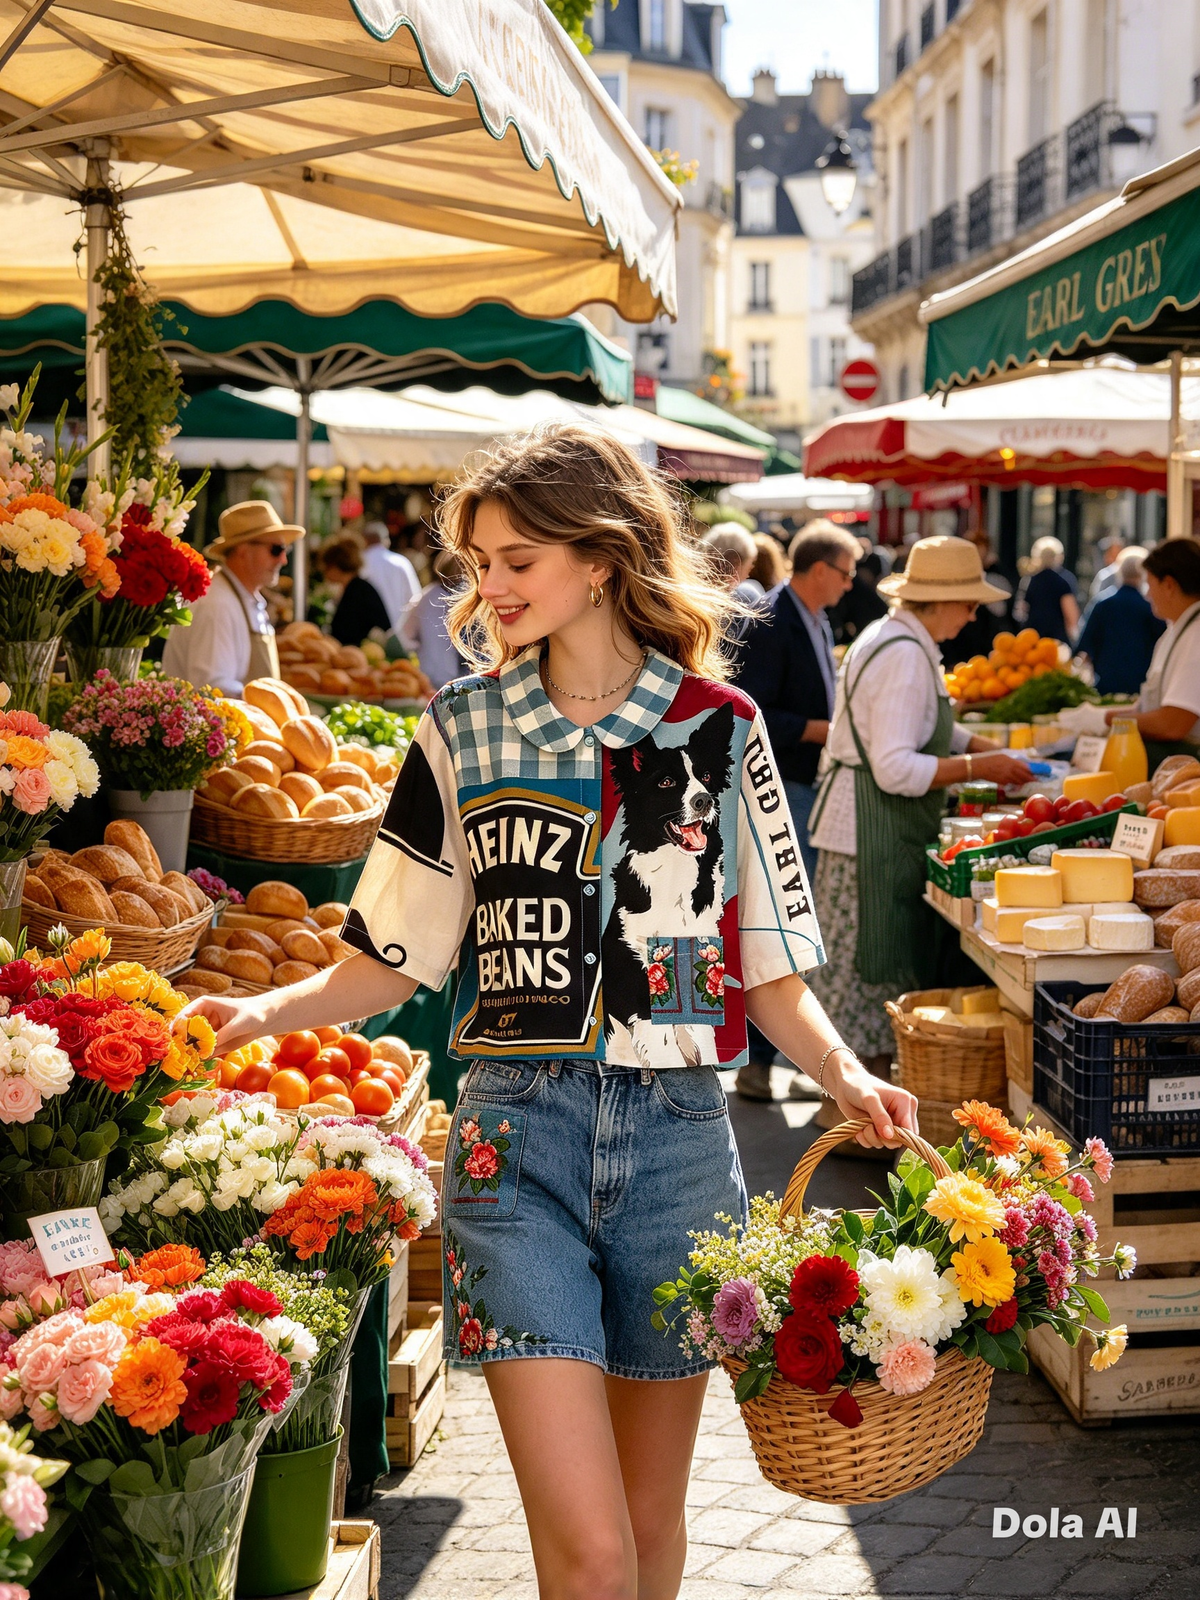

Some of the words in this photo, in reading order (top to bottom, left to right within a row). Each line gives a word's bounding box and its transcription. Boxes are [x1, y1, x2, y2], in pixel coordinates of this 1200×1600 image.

[1026, 271, 1085, 340] EARL
[467, 816, 572, 880] HEINZ
[476, 897, 571, 946] BAKED
[478, 947, 572, 992] BEANS
